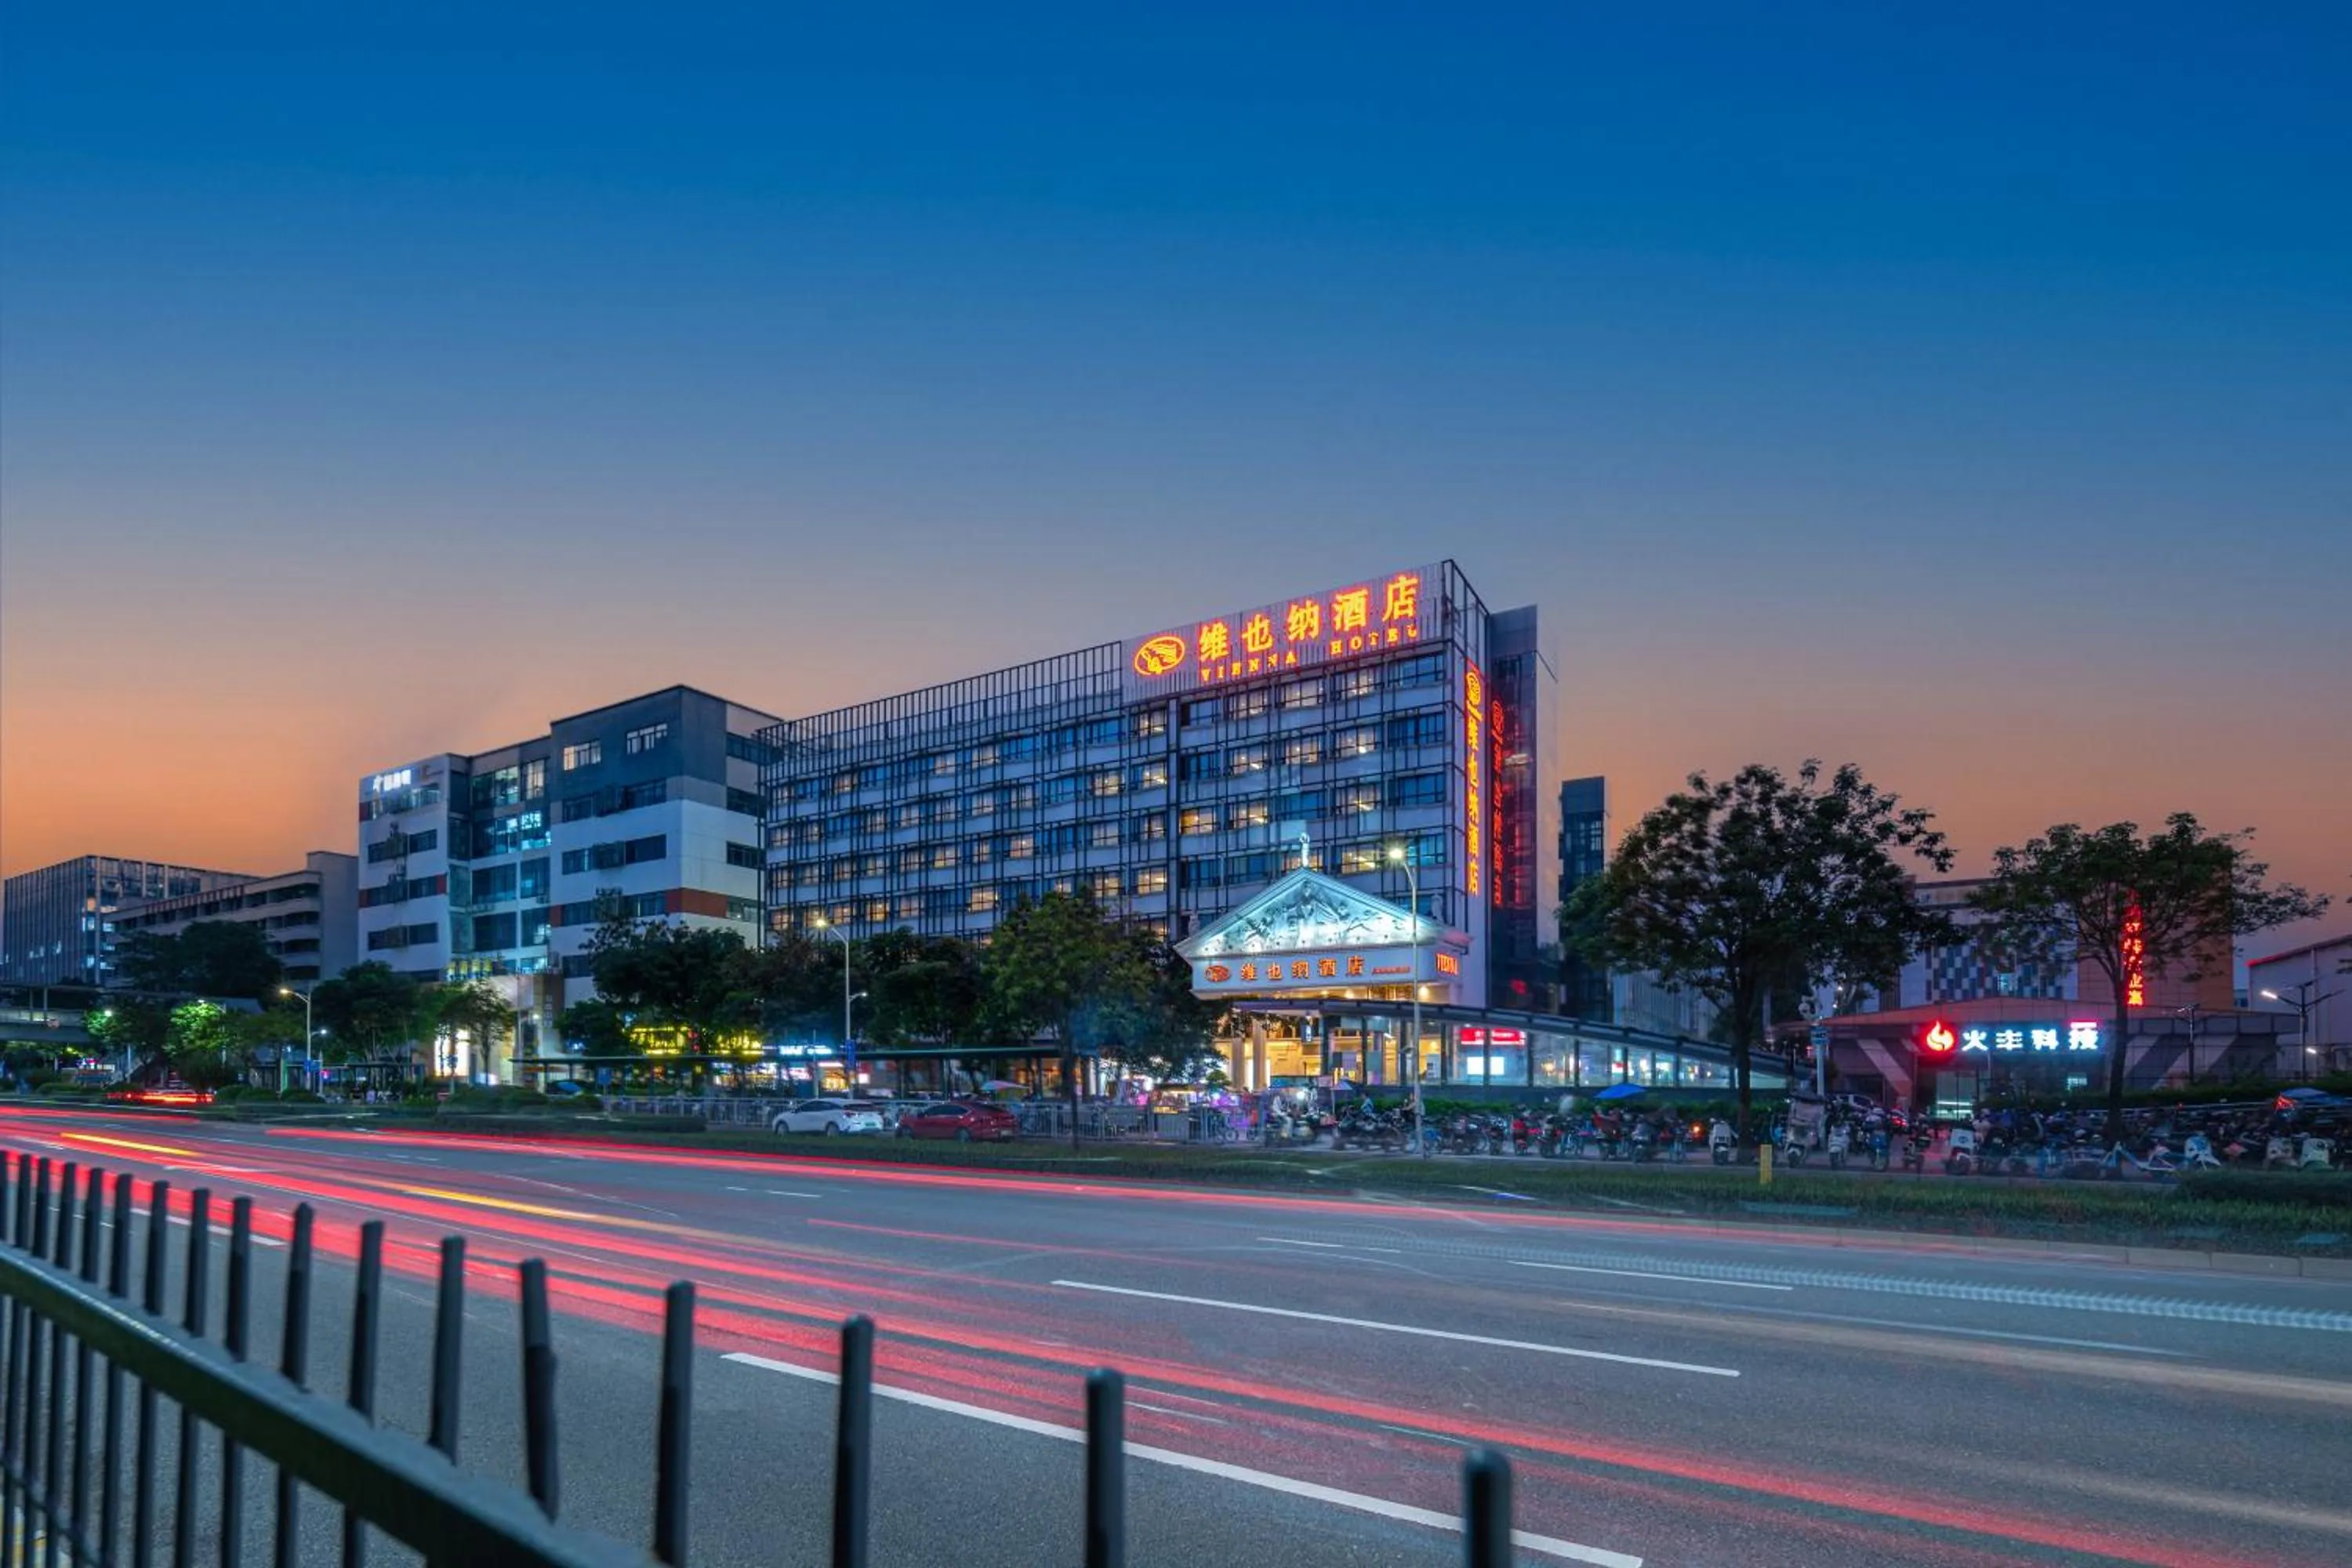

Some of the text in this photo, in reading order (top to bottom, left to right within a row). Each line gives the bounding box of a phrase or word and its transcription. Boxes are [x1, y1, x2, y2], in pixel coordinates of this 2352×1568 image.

[1198, 574, 1419, 662] 维也纳酒店
[1200, 651, 1298, 681] VIENNA
[1241, 955, 1365, 980] 维也纳酒店
